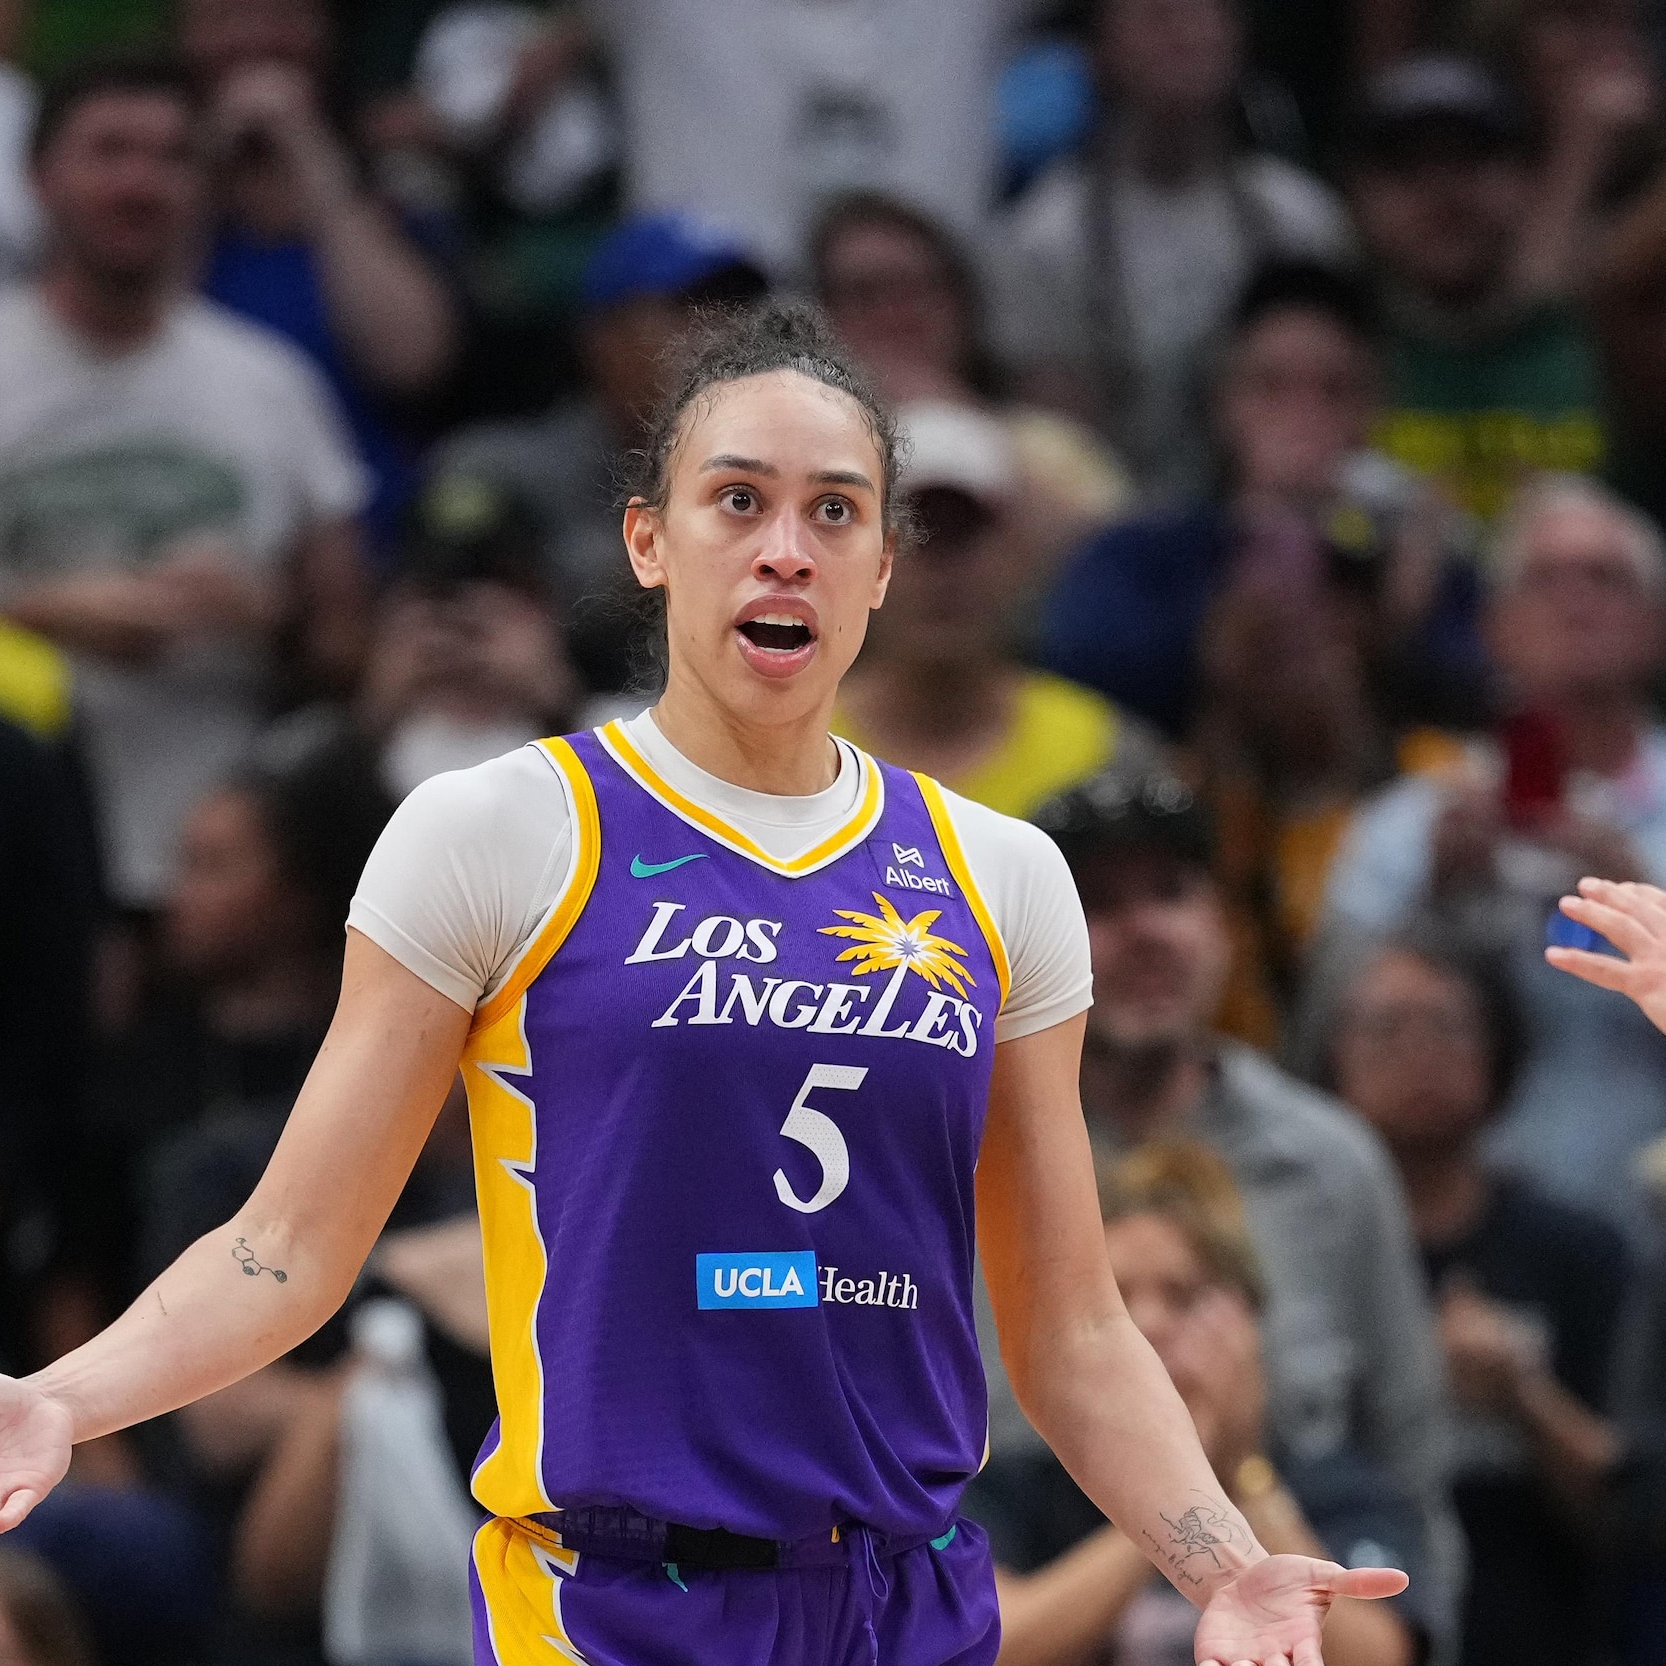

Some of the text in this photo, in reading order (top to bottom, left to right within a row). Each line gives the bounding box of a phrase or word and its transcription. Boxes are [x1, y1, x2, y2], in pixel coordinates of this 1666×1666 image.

[885, 865, 950, 896] Albert
[773, 1063, 869, 1214] 5
[714, 1265, 919, 1310] UCLA Health
